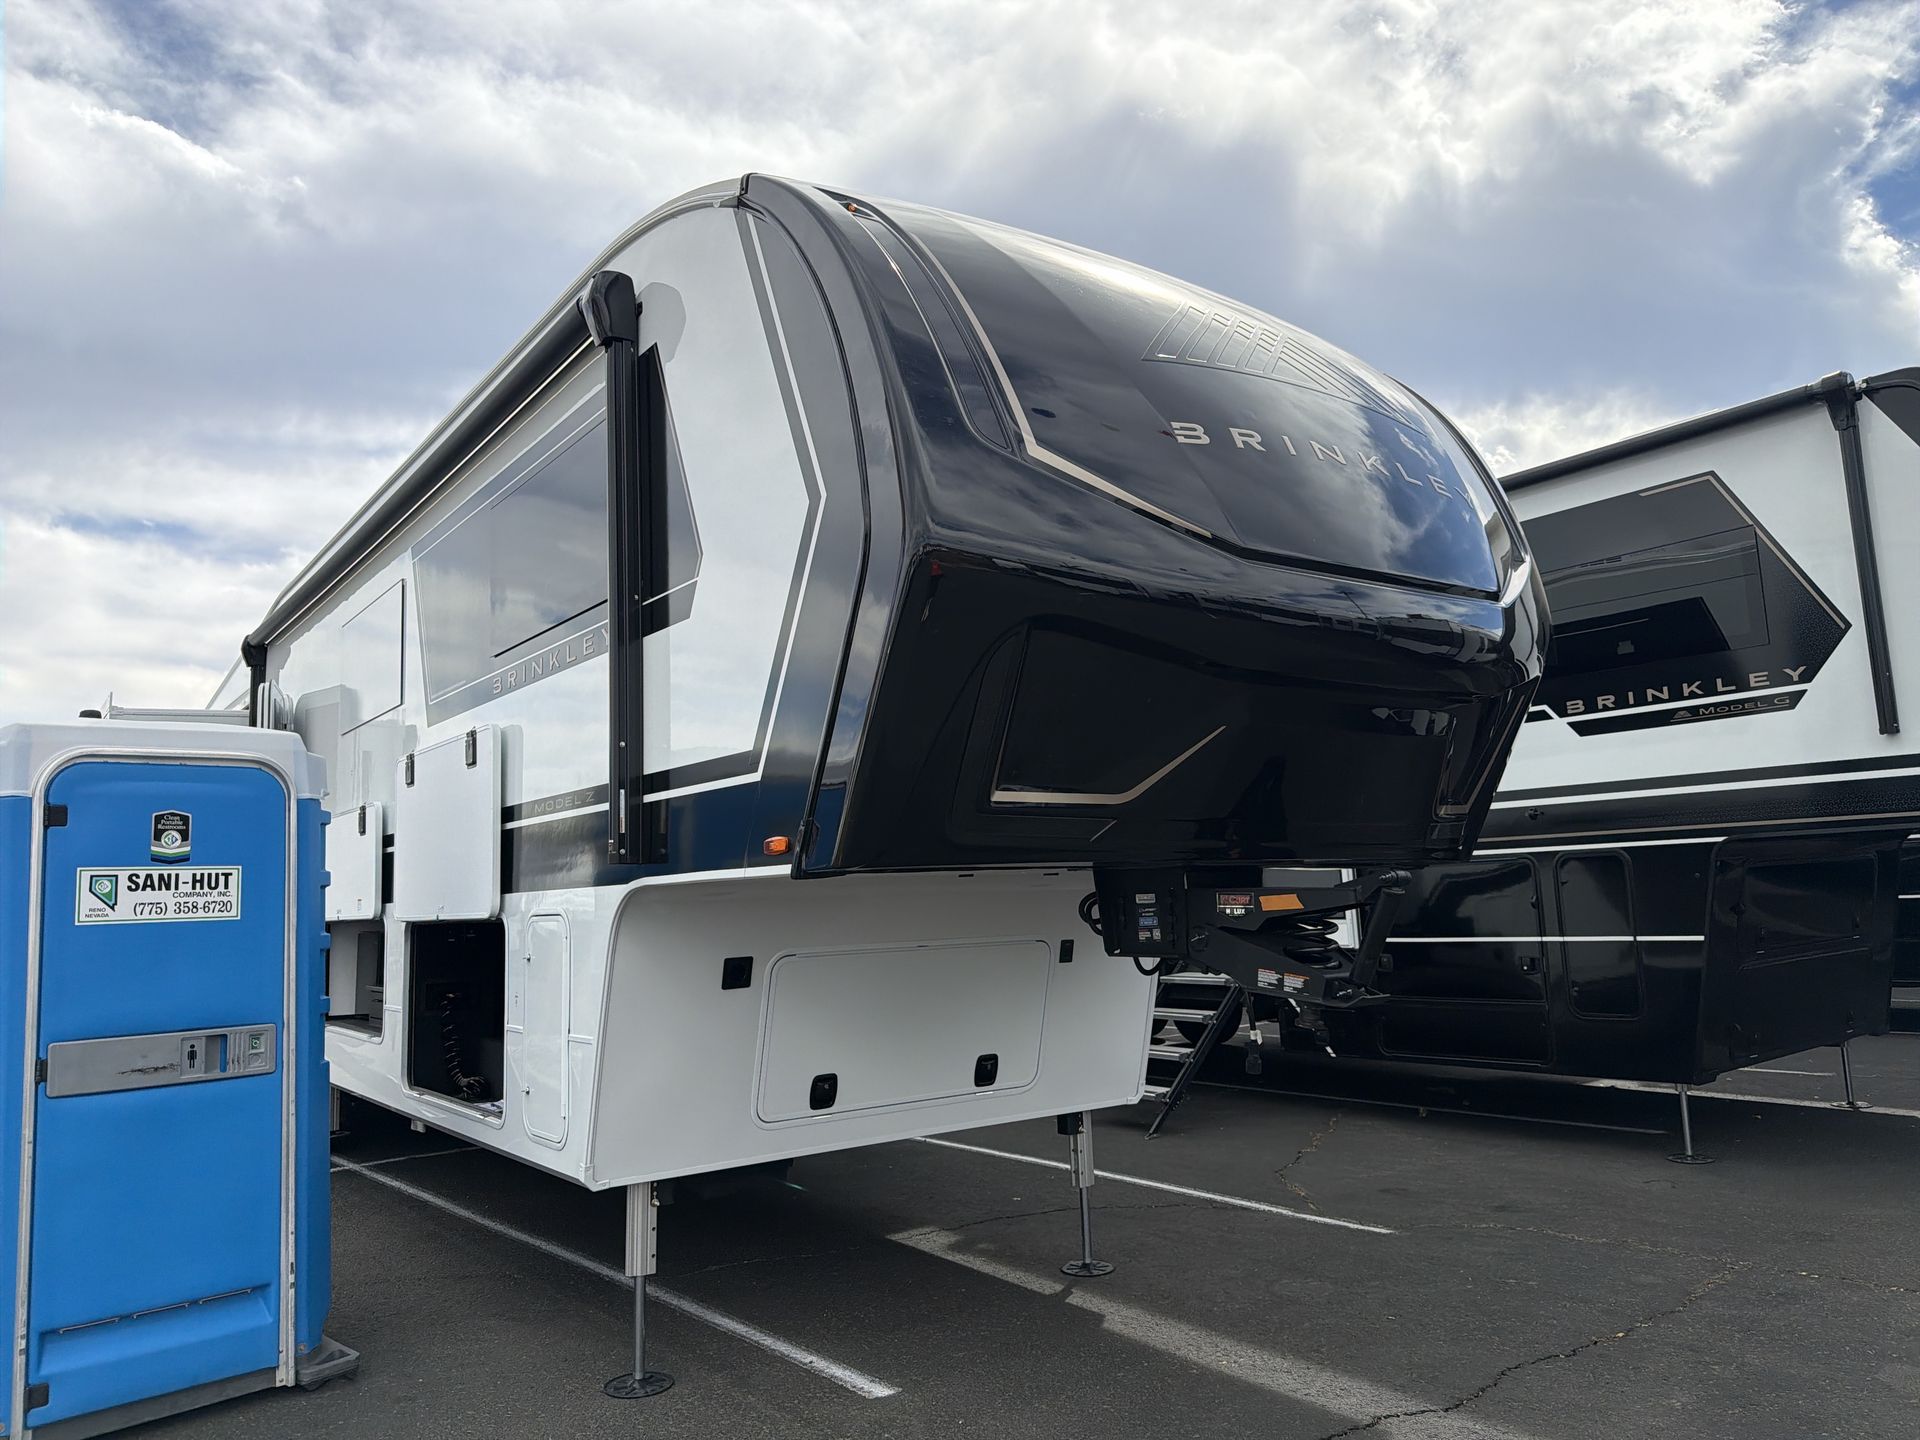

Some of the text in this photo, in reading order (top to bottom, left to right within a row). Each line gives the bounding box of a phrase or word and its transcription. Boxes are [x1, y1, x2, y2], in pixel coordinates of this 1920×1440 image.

[1170, 421, 1474, 509] BRINKLEY
[1566, 665, 1807, 714] BRINKLEY
[1699, 696, 1790, 716] MODEL G
[534, 791, 595, 815] MODEL Z
[127, 872, 233, 892] SANI-HUT
[172, 890, 233, 899] COMPANY, INC.
[133, 900, 233, 917] (775) 358-6720
